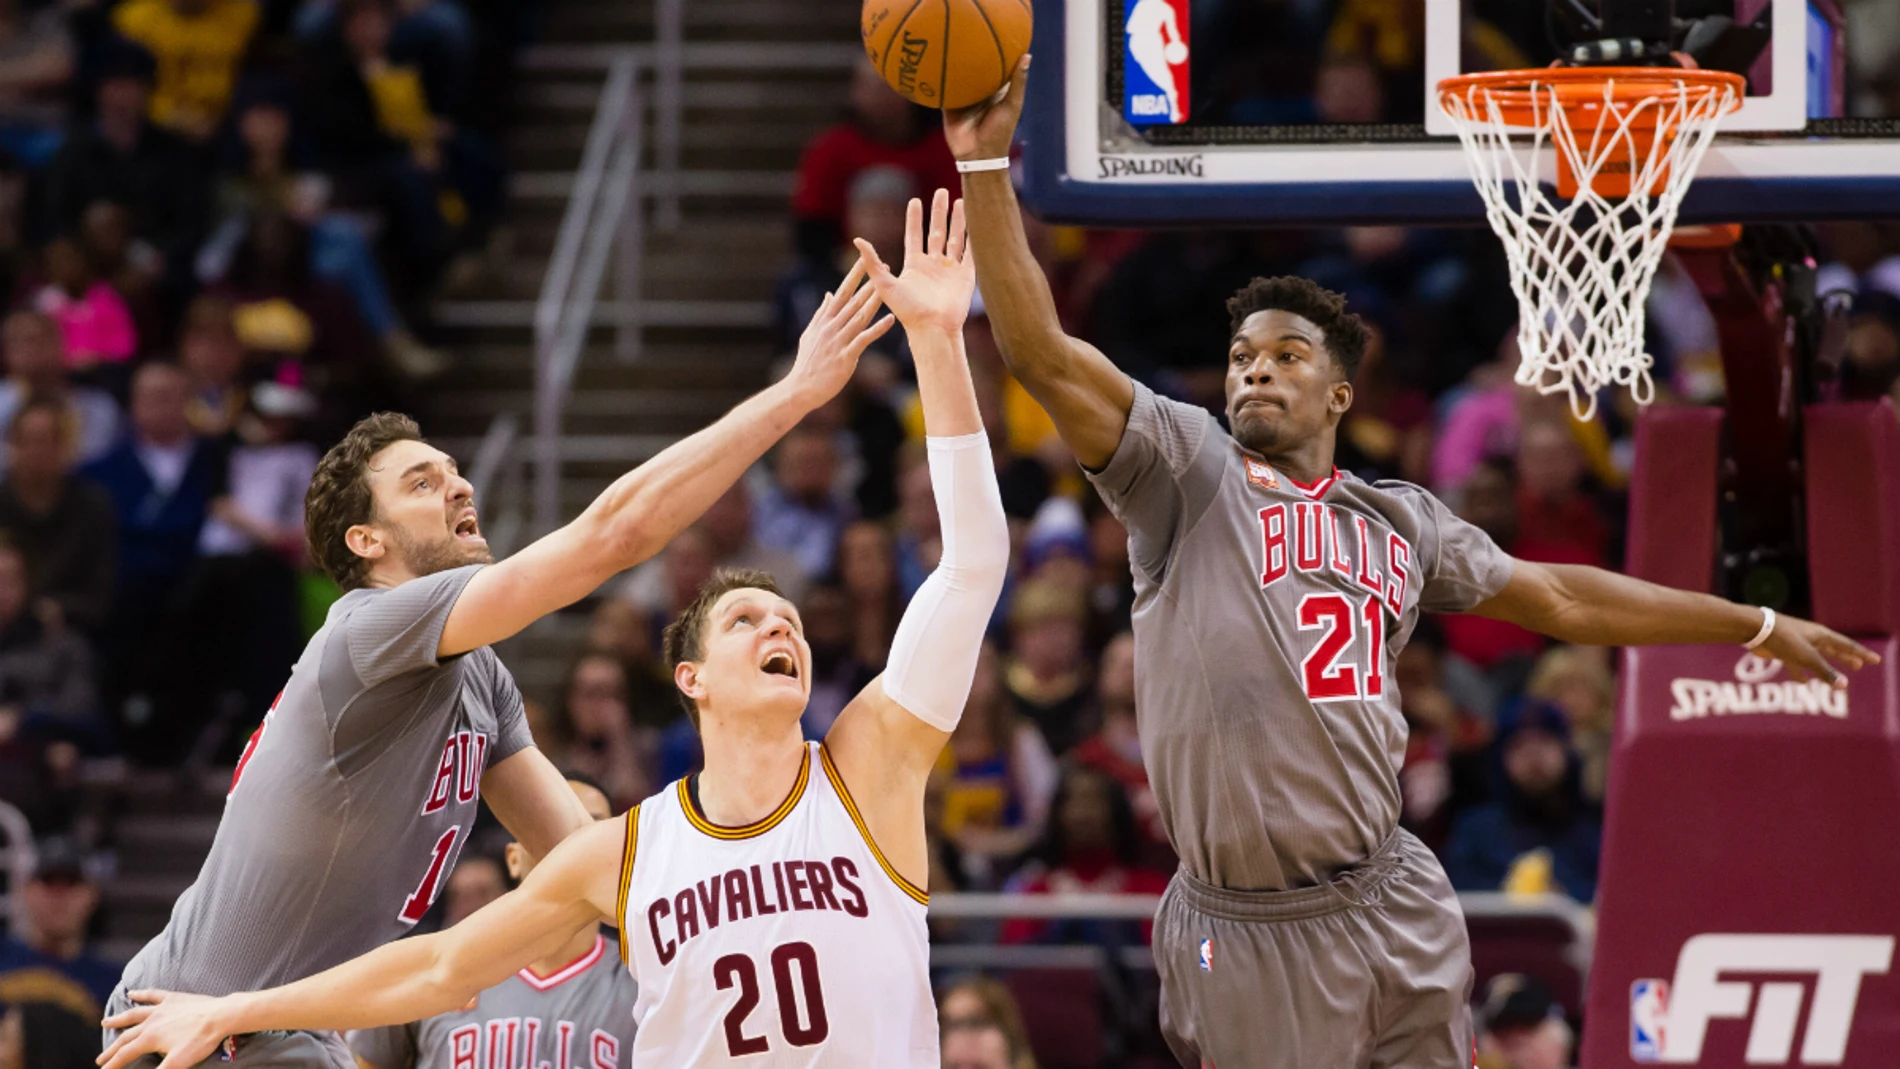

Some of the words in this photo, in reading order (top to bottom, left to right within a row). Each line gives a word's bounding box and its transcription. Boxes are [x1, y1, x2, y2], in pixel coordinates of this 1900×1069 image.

[1131, 94, 1169, 115] NBA
[1098, 154, 1203, 179] SPALDING
[1257, 501, 1410, 621] BULLS
[1296, 592, 1383, 701] 21
[1670, 676, 1848, 721] SPALDING
[421, 731, 487, 816] BU
[397, 824, 465, 925] 1
[647, 856, 869, 967] CAVALIERS
[448, 1016, 620, 1069] BULLS
[712, 940, 829, 1058] 20
[1662, 932, 1895, 1066] FIT
